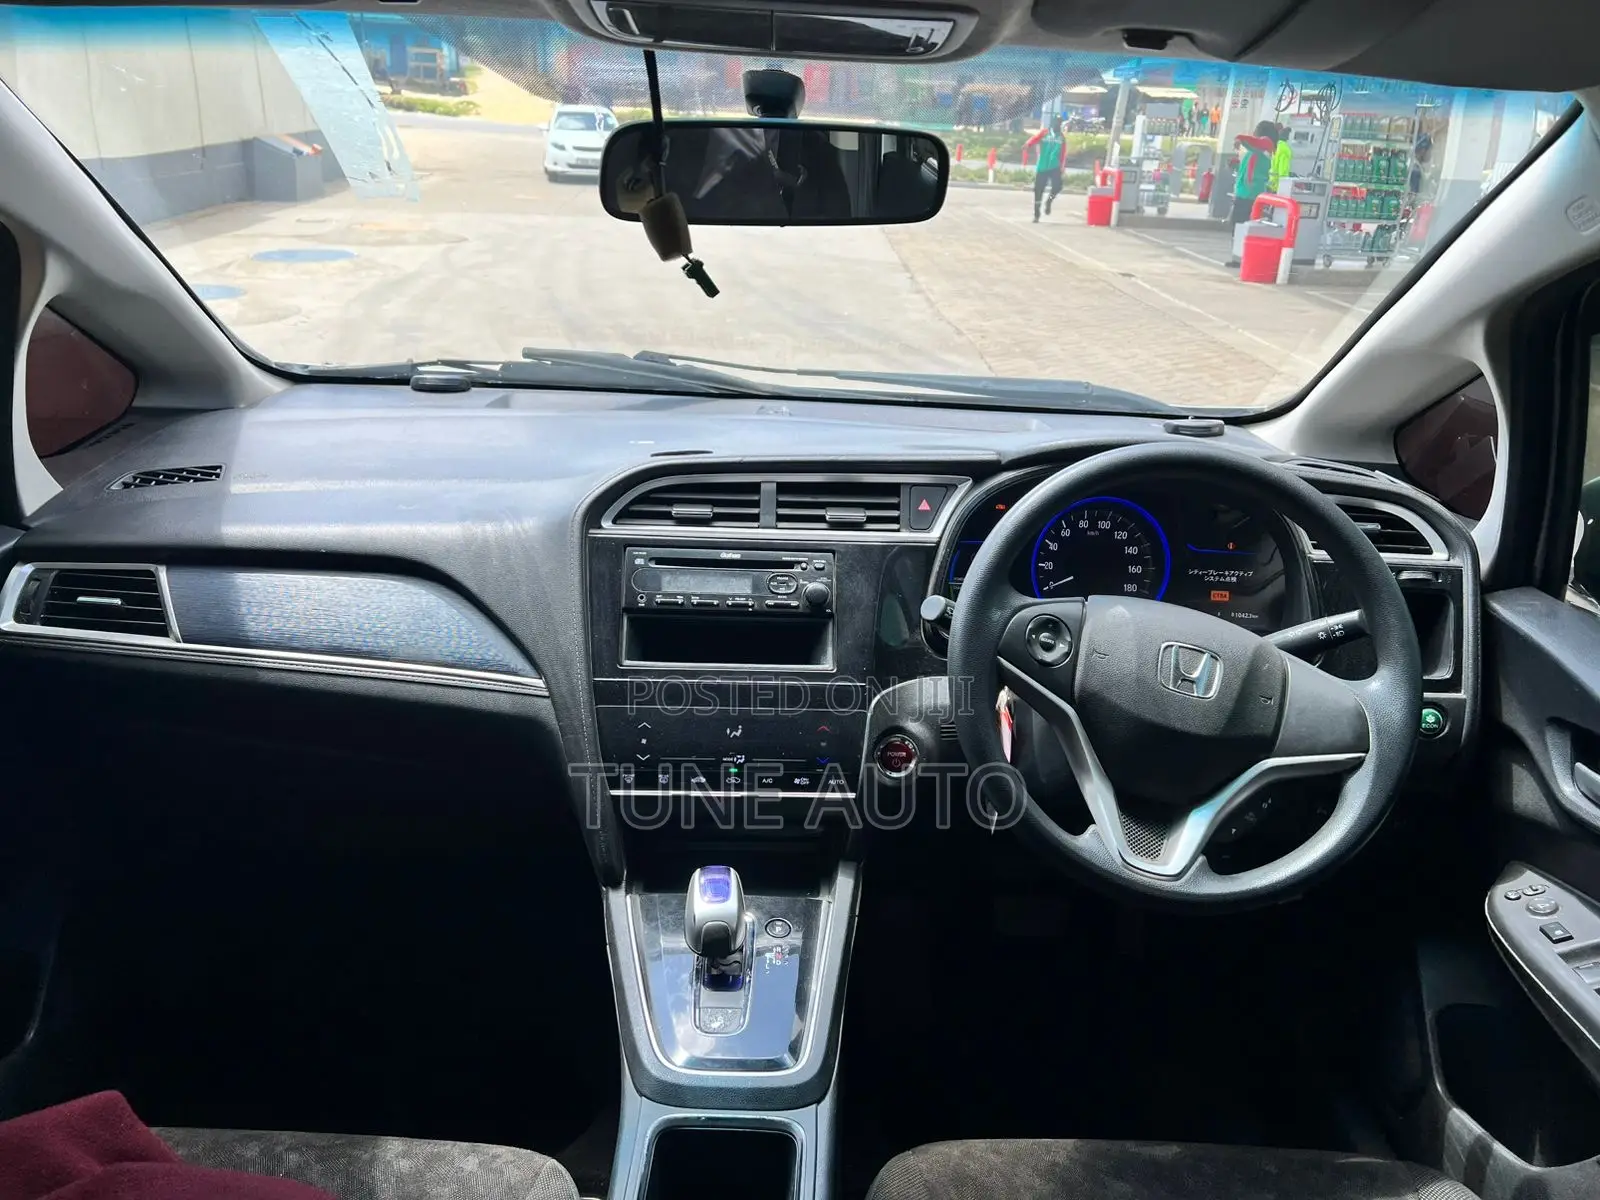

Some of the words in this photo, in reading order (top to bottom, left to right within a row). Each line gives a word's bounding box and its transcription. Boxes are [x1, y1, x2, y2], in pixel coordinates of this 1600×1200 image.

[1078, 520, 1089, 529] 80
[1097, 520, 1111, 529] 100
[1060, 528, 1071, 537] 60
[1114, 531, 1128, 540] 120
[1049, 542, 1058, 551] 40
[1124, 546, 1138, 555] 140
[1044, 561, 1053, 570] 20
[1128, 565, 1142, 574] 160
[1123, 584, 1138, 592] 180
